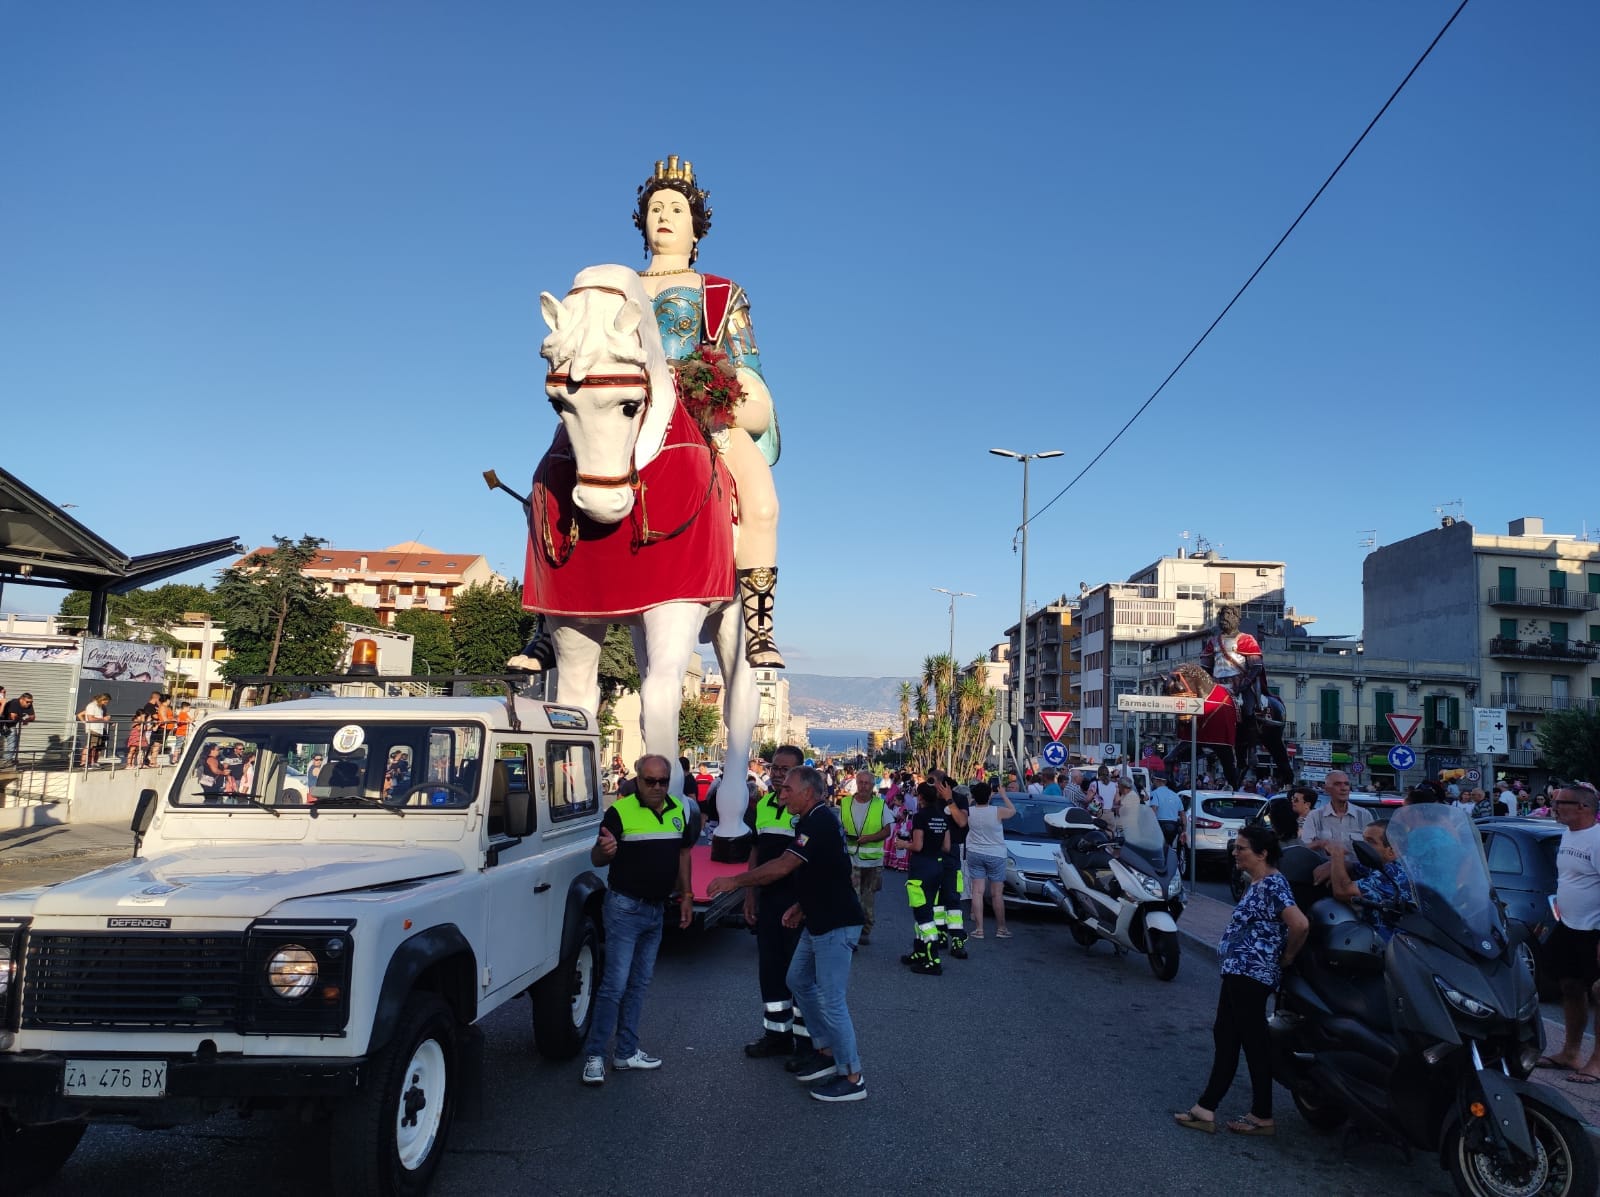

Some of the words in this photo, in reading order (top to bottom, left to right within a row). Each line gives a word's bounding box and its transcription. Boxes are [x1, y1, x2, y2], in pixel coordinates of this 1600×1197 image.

[1119, 698, 1160, 709] Farmacia
[110, 918, 168, 928] DEFENDER
[66, 1067, 87, 1088] ZA
[99, 1068, 132, 1088] 476
[141, 1068, 164, 1089] BX
